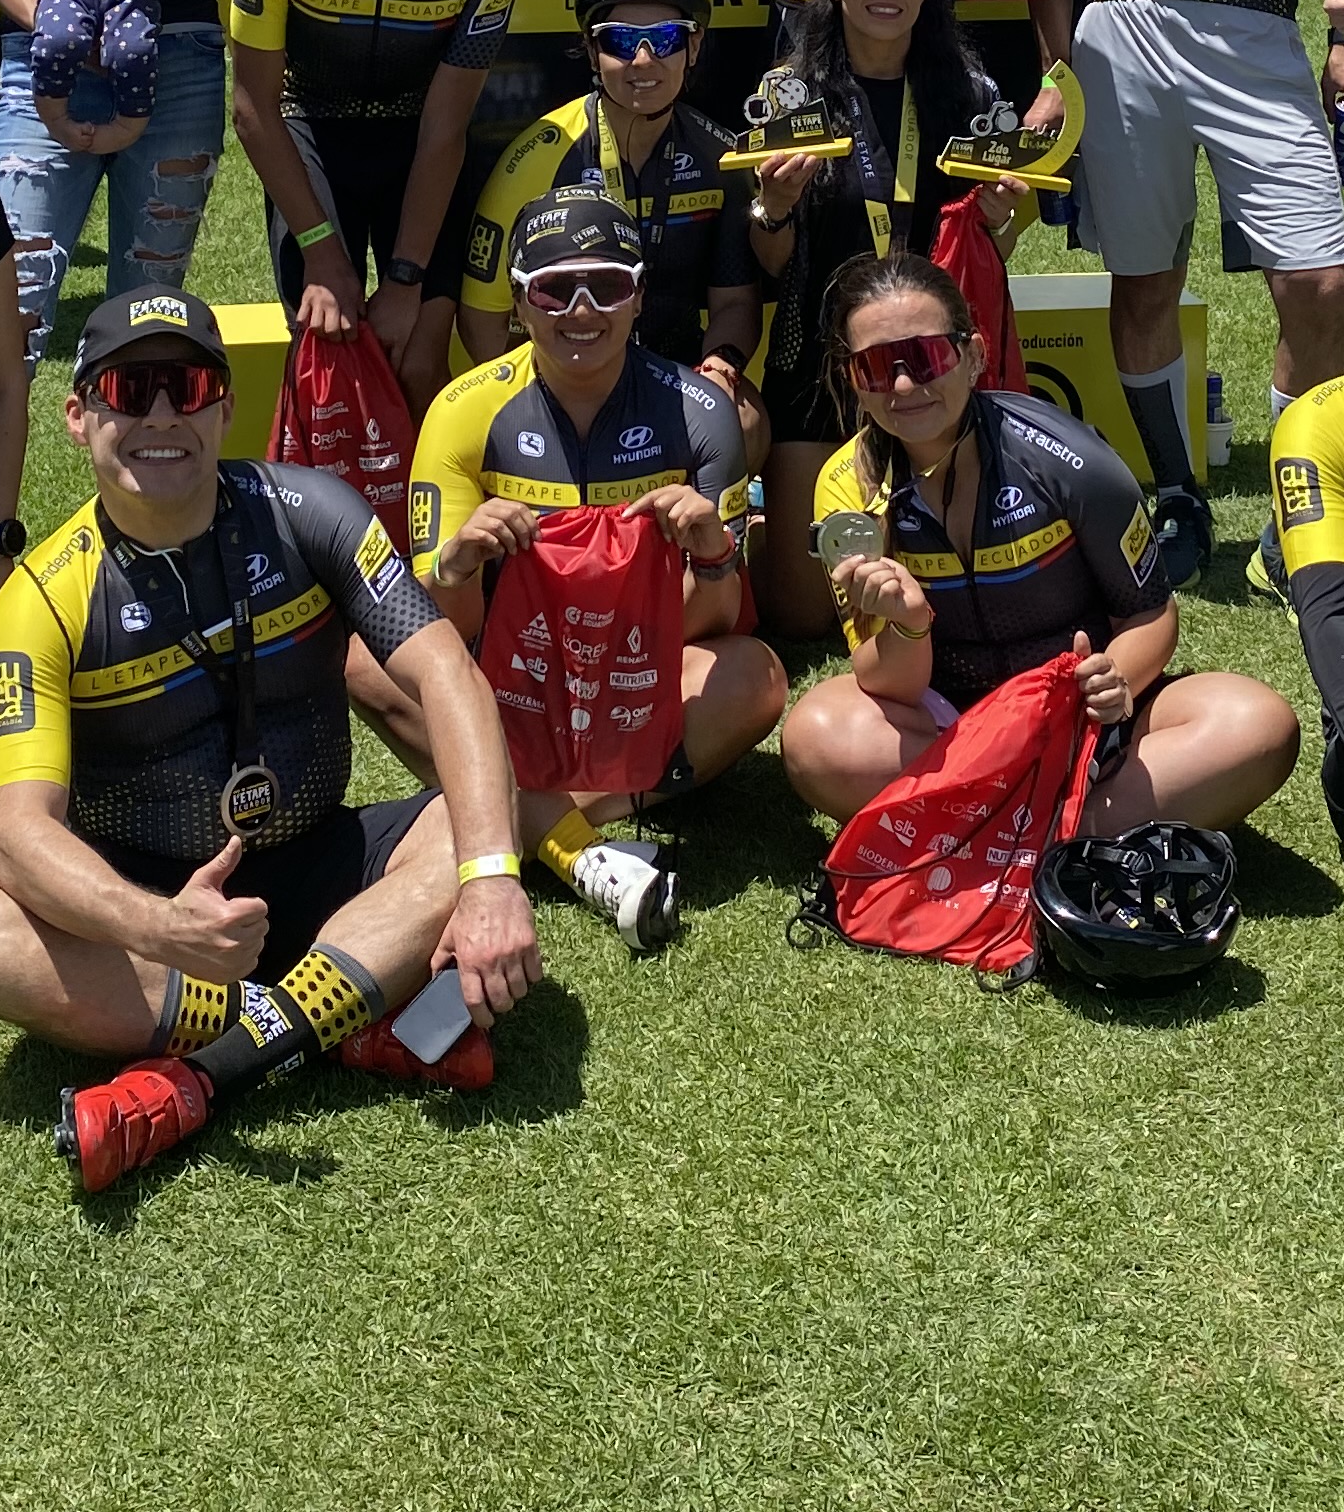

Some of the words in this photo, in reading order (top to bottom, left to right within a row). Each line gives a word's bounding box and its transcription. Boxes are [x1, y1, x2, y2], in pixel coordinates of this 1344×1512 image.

[388, 0, 465, 16] ECUADOR
[981, 150, 1013, 166] Lugar
[987, 140, 1010, 155] 2do
[445, 362, 499, 403] endepro
[672, 376, 717, 411] austro
[613, 444, 662, 465] HYUNDAI
[1035, 431, 1085, 471] austro
[979, 523, 1065, 567] ECUADOR
[894, 819, 917, 839] slb
